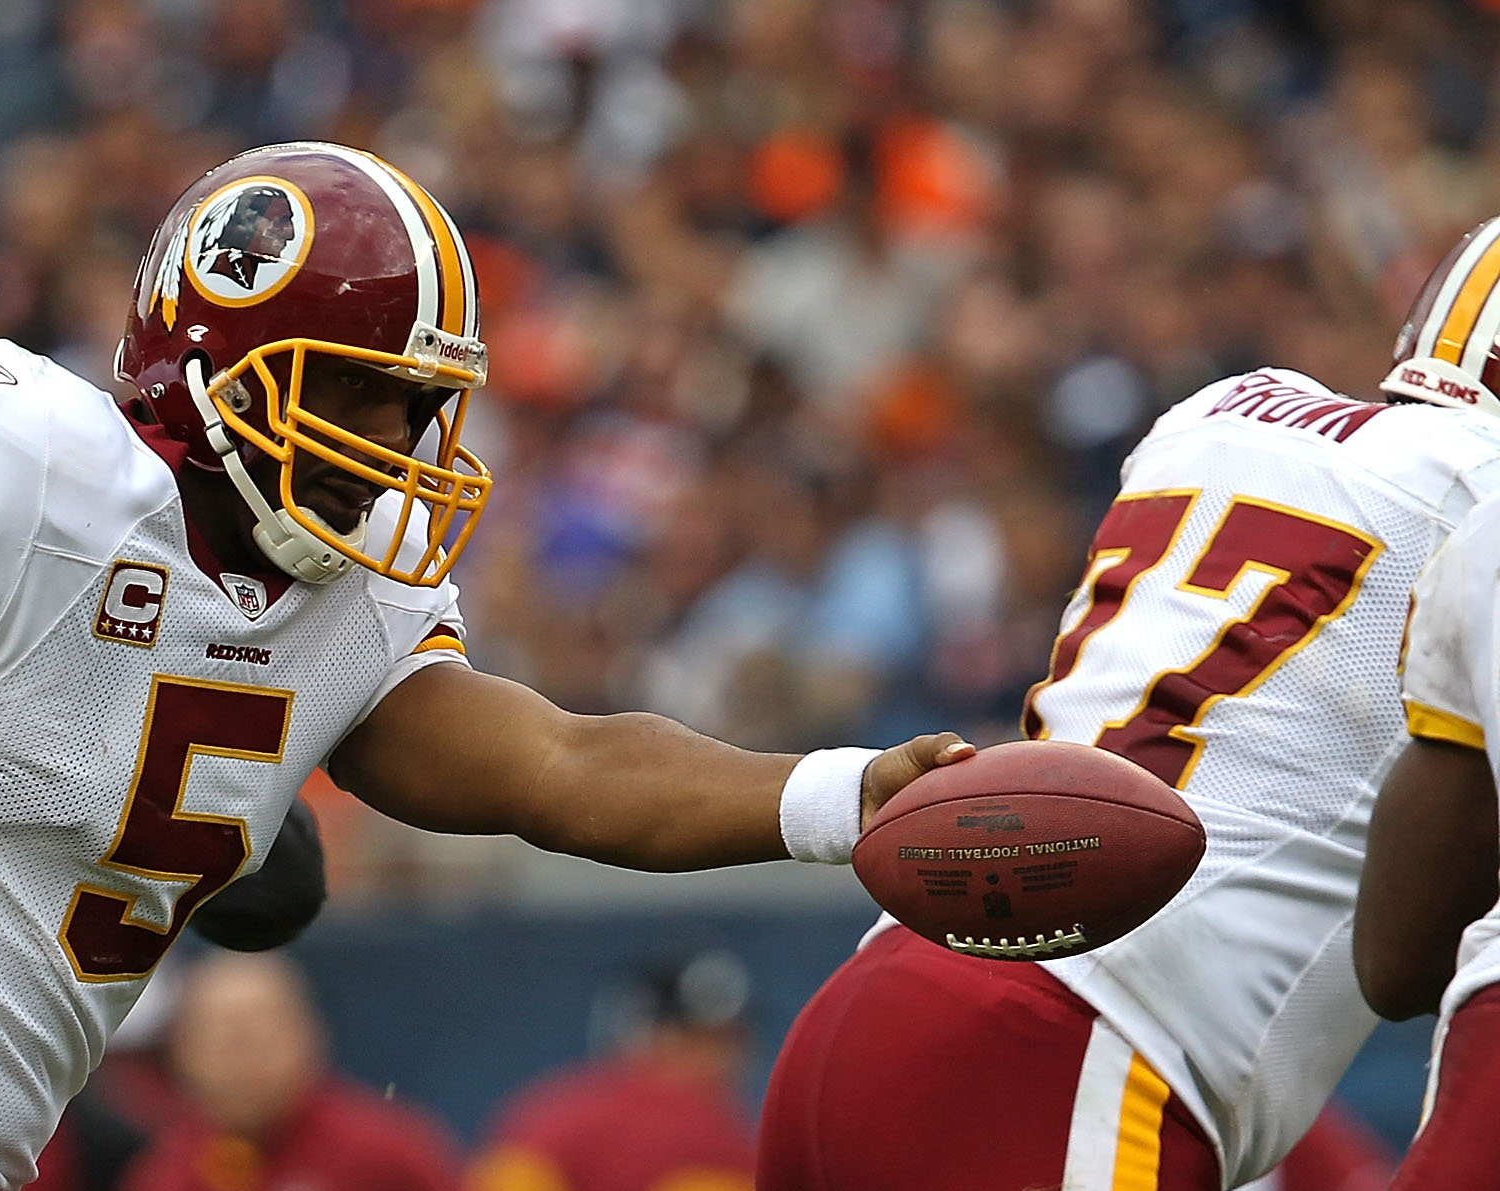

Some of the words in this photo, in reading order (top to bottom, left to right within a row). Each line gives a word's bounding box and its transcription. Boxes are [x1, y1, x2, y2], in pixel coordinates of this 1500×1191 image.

[1401, 367, 1480, 405] REDKINS
[104, 567, 164, 624] C
[1019, 487, 1389, 791] 77
[205, 643, 273, 666] REDSKINS
[56, 672, 297, 984] 5
[899, 846, 943, 861] LEAGUE
[947, 846, 1020, 861] FOOTBALL
[1025, 836, 1100, 857] NATIONAL
